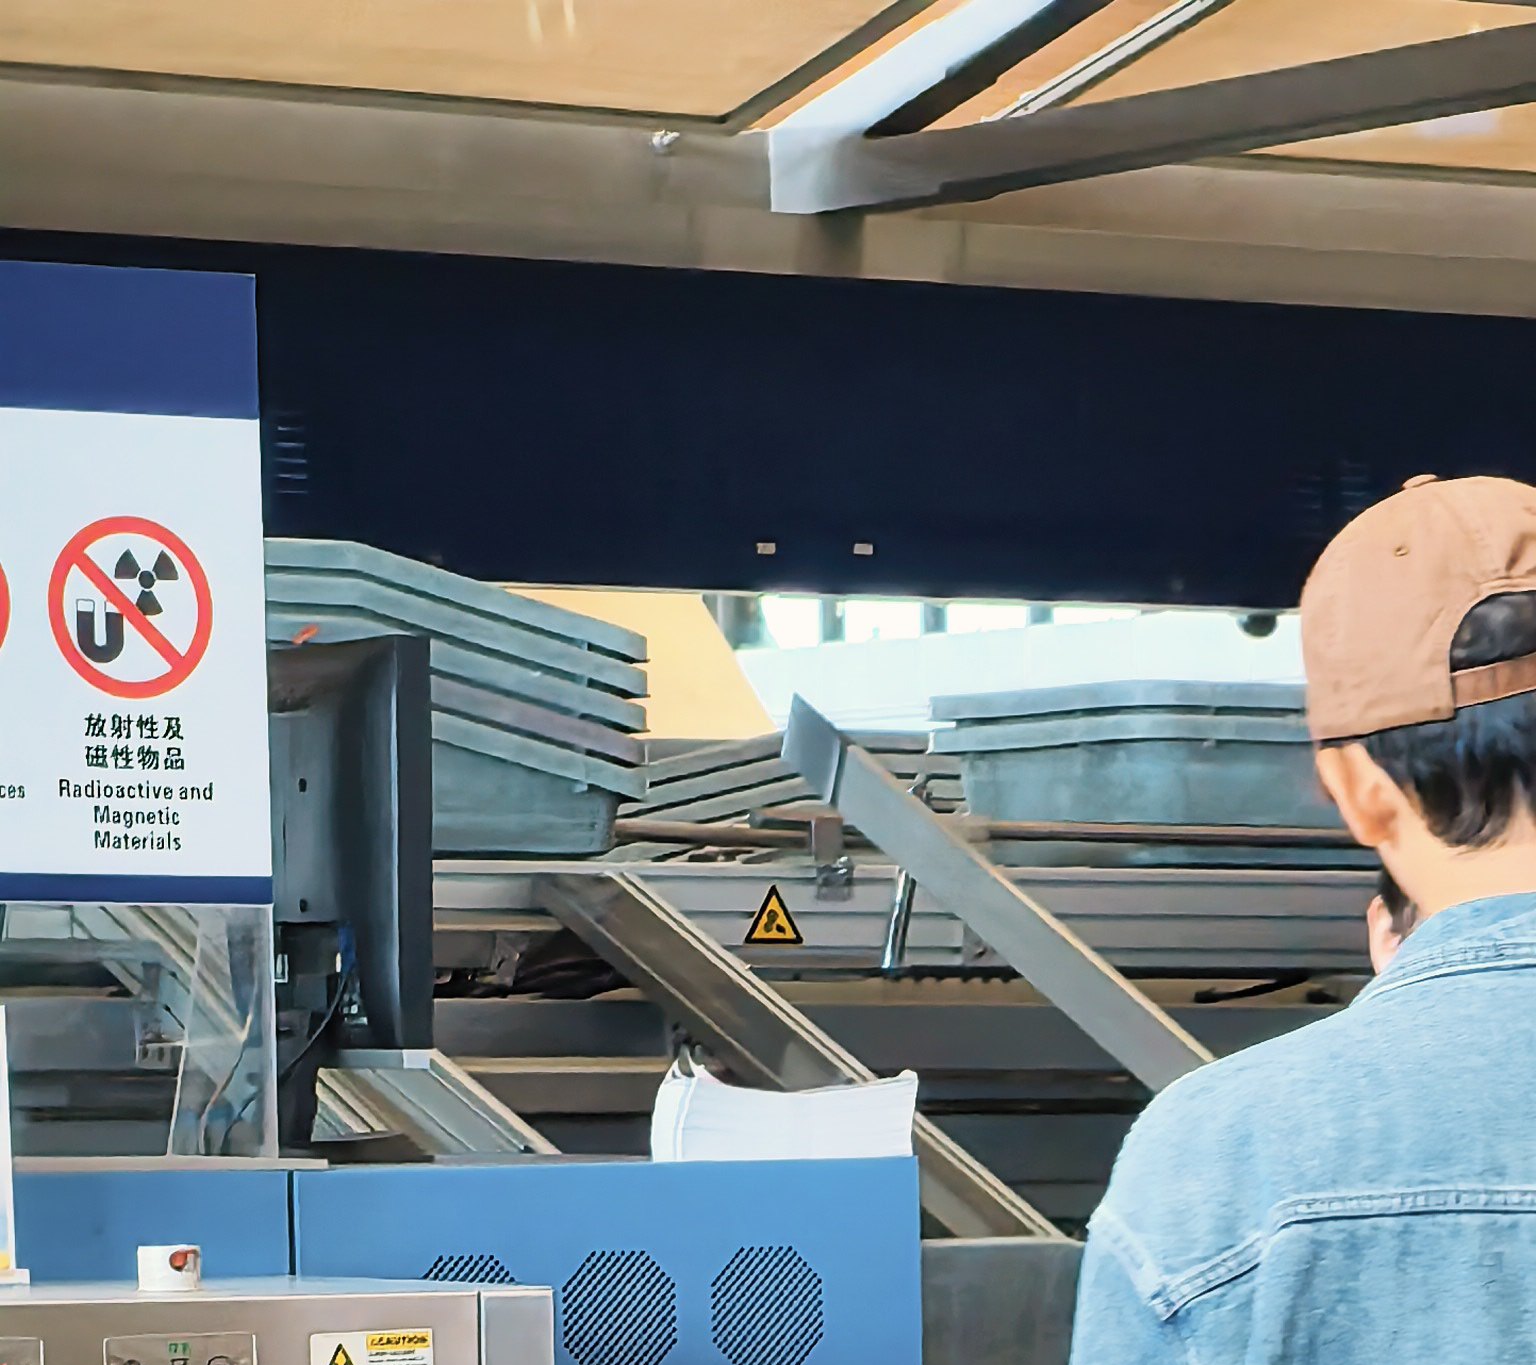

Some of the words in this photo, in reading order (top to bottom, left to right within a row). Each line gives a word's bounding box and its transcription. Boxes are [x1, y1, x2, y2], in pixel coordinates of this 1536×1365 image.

[84, 713, 184, 740] 放射性及
[85, 744, 184, 770] 磁性物品
[59, 778, 173, 799] Radioactive
[179, 782, 213, 801] and
[94, 805, 180, 828] Magnetic
[94, 830, 181, 850] Materials
